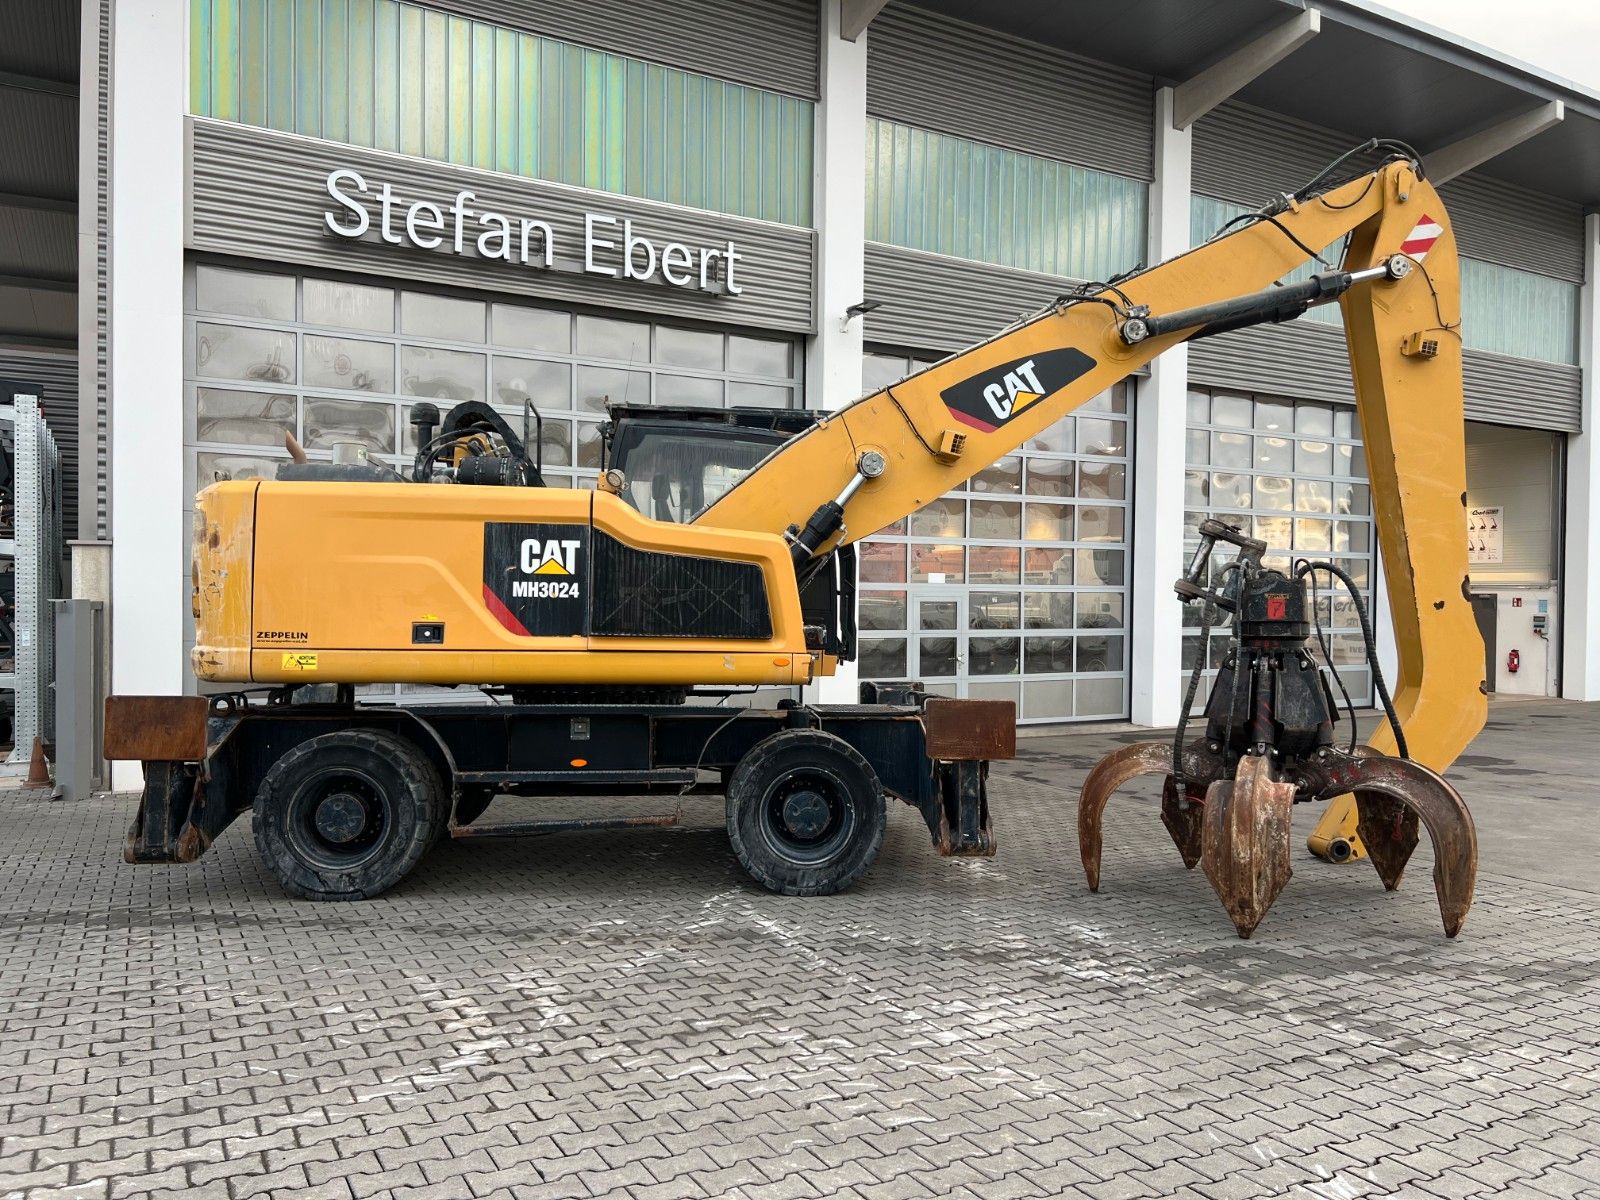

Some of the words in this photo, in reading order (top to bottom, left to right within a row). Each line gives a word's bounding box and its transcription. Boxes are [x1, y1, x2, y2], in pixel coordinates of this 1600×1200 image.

[324, 169, 554, 266] Stefan
[585, 212, 743, 295] Ebert
[982, 359, 1046, 421] CAT
[520, 538, 581, 575] CAT
[512, 581, 580, 599] MH3024
[257, 631, 308, 639] ZEPPELIN
